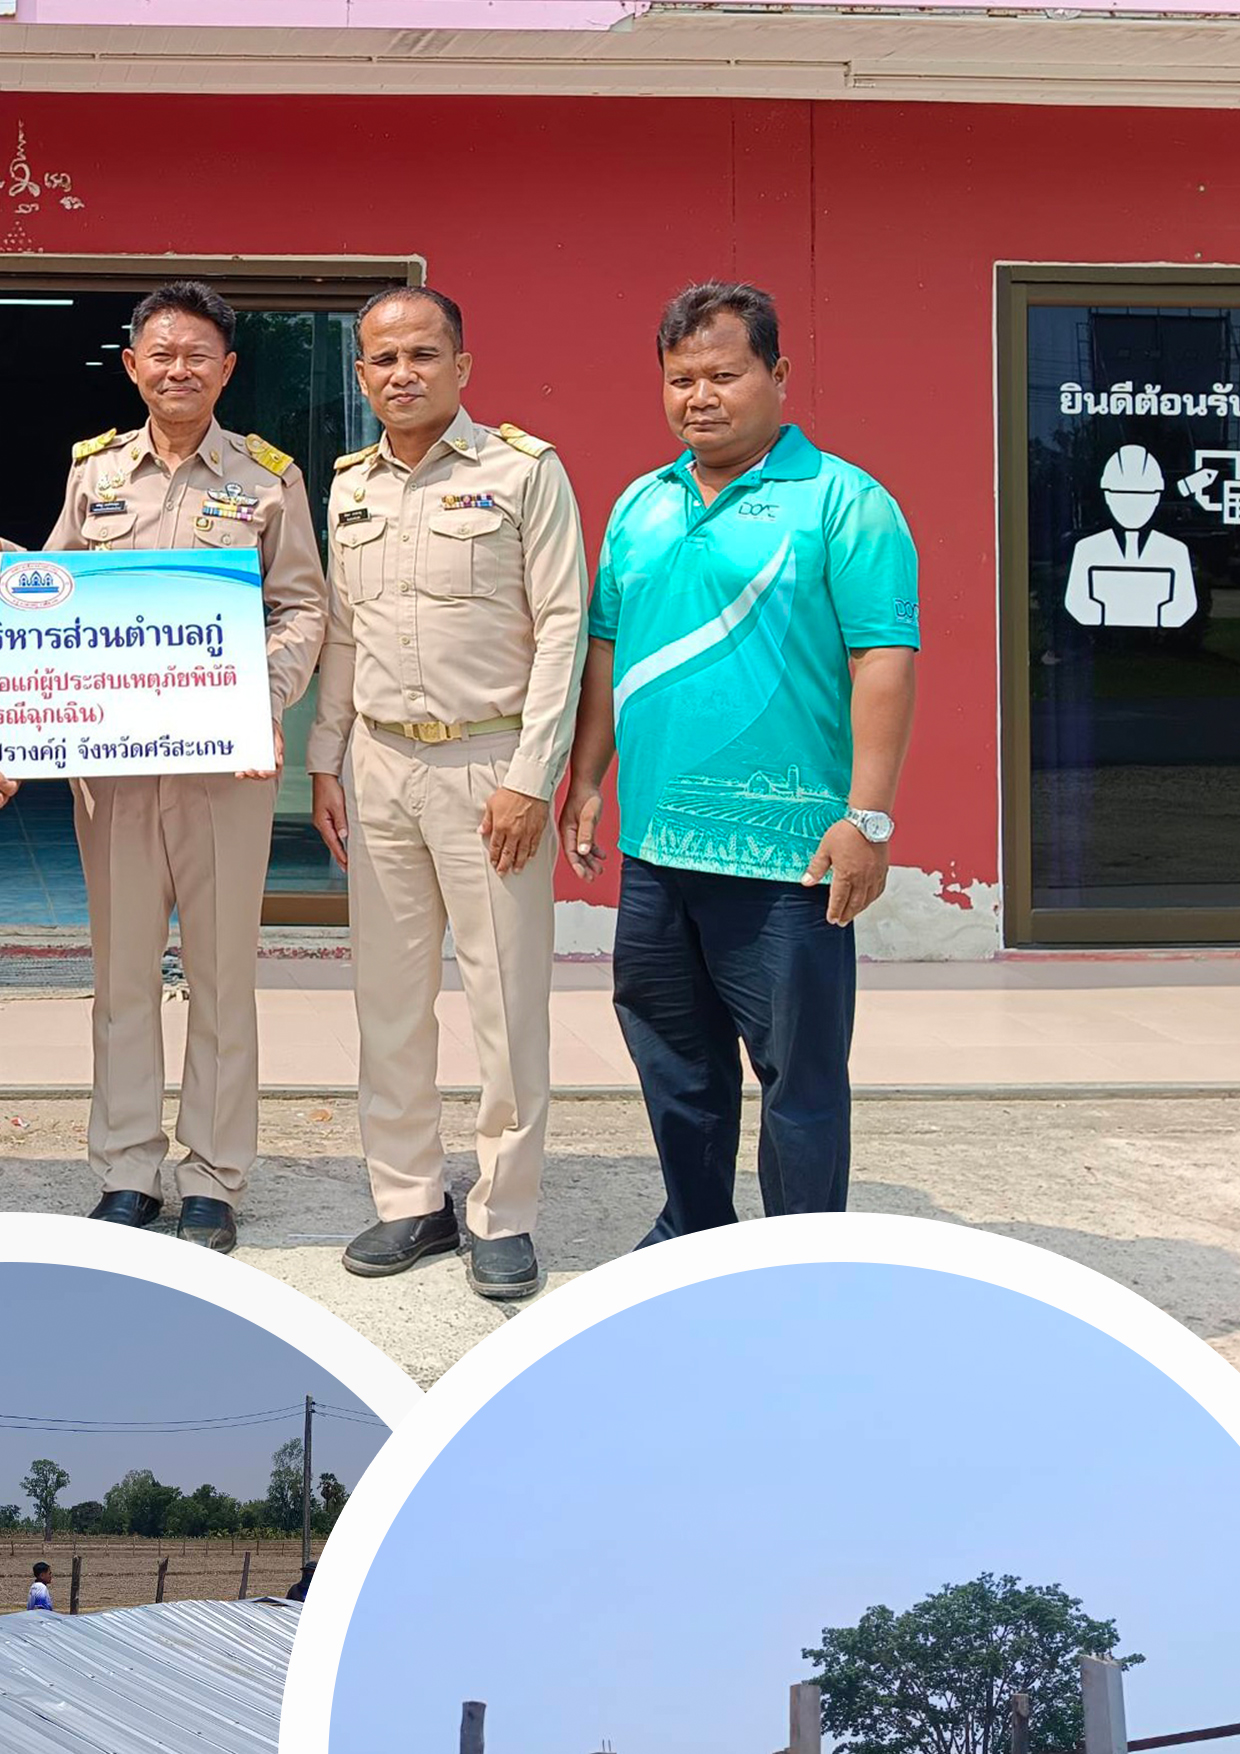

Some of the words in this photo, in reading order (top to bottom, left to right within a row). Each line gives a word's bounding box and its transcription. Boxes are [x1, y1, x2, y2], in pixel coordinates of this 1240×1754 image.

[77, 734, 235, 761] จังหวัดศรีสะเกษ
